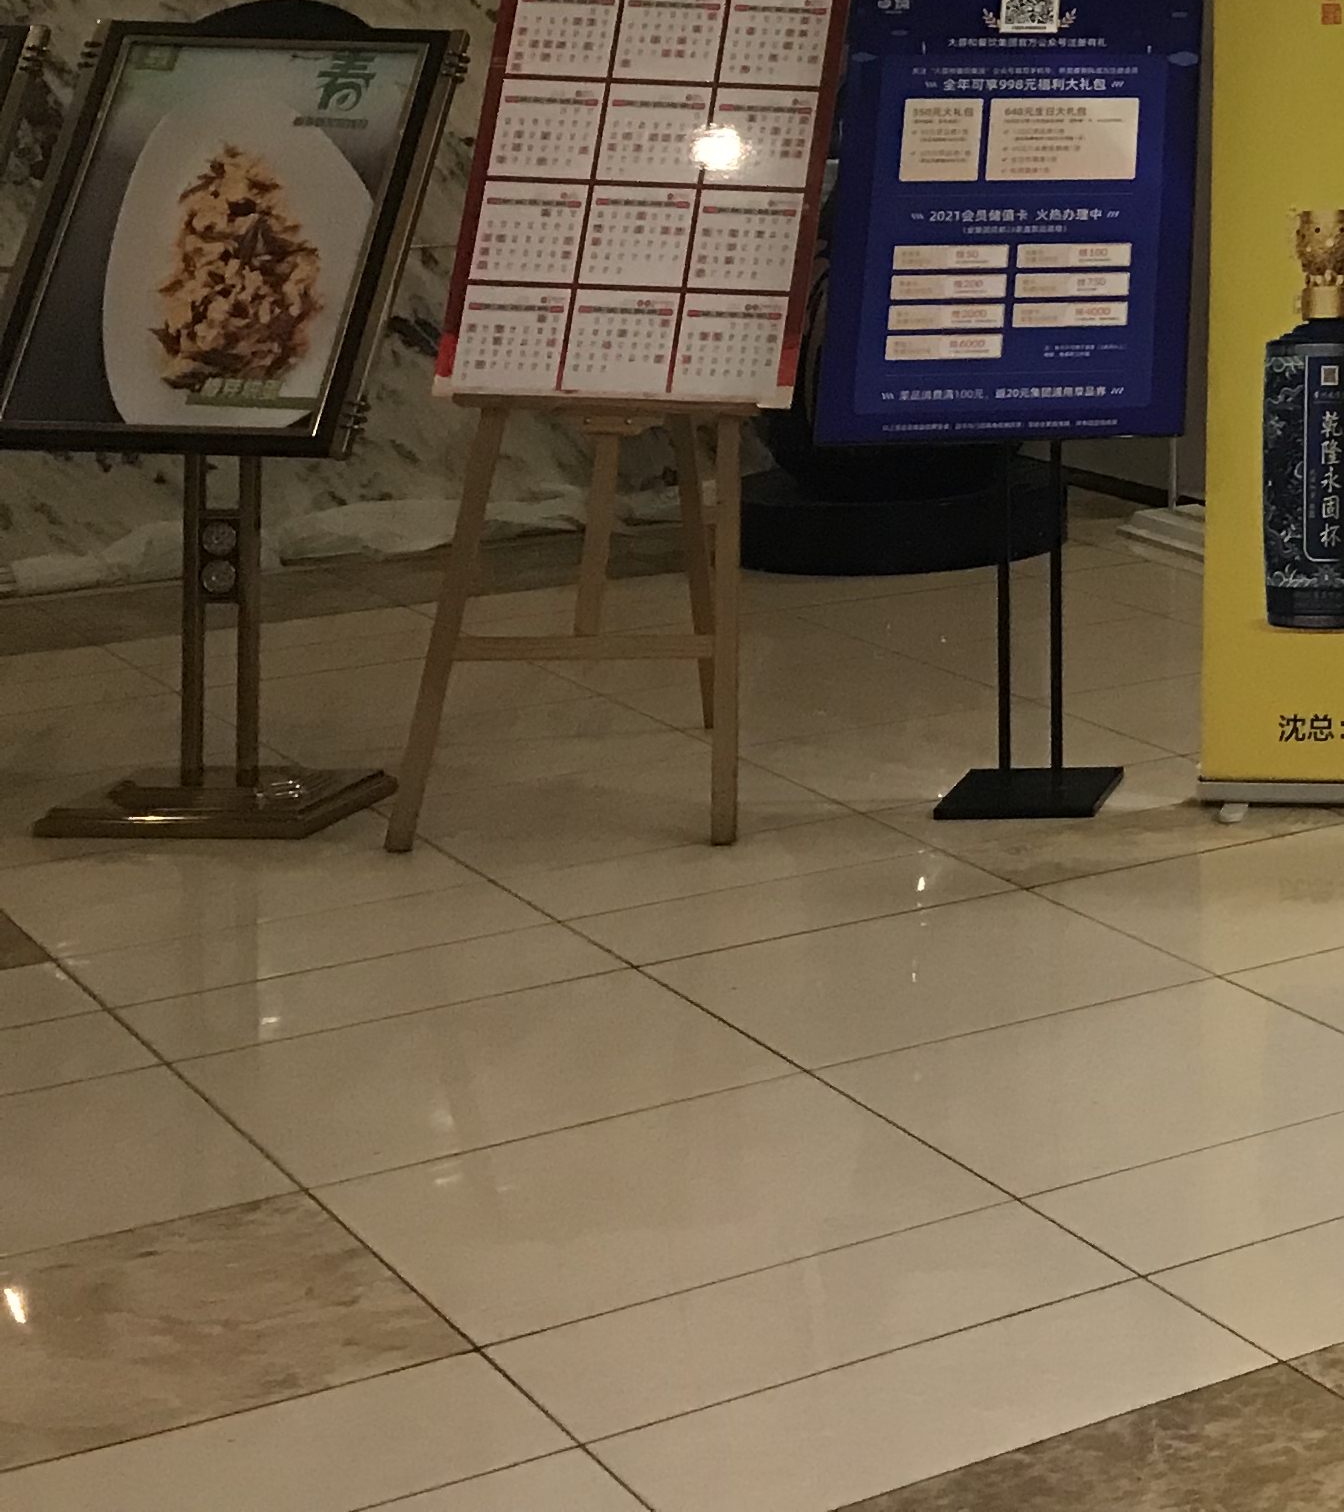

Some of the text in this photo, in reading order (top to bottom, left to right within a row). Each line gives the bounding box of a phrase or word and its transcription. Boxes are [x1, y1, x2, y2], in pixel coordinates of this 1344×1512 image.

[1320, 410, 1344, 549] 乾隆永固杯
